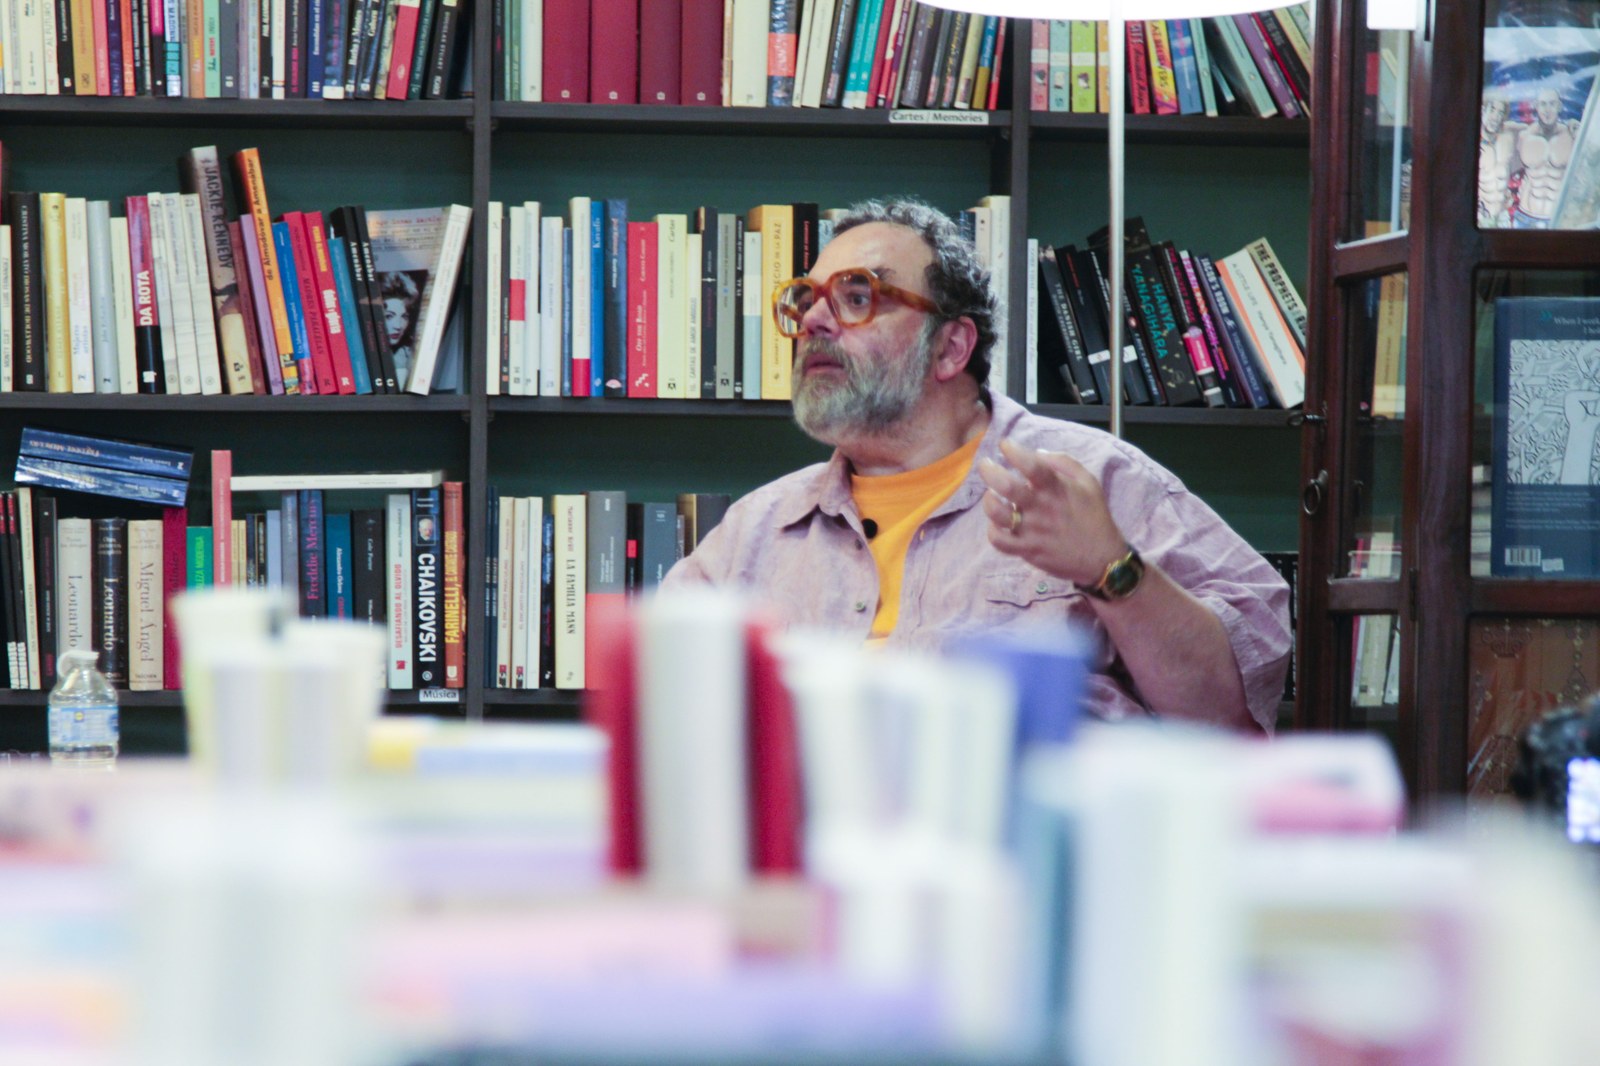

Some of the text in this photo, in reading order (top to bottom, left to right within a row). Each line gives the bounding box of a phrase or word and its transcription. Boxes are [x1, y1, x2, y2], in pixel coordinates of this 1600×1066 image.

[438, 12, 450, 70] DOUGLAS STUART
[1154, 38, 1169, 88] BELIEVERS
[892, 112, 924, 122] Cartes
[933, 111, 982, 123] Memòries
[248, 158, 260, 206] Amenábar
[205, 168, 232, 269] JACKIE KENNEDY
[258, 218, 270, 266] Almodóvar
[266, 270, 273, 281] de
[351, 242, 362, 282] Amenábar
[363, 242, 374, 282] Amenábar
[1254, 242, 1298, 312] THE PROPHETS
[24, 304, 30, 314] DE
[136, 270, 150, 304] ROTA
[1152, 284, 1175, 331] HANYA
[1200, 258, 1230, 315] JACOB'S ROOM
[1235, 269, 1250, 292] LITTLE
[1248, 292, 1258, 306] LIFE
[1258, 311, 1269, 330] Hanya
[140, 307, 152, 326] DA
[304, 278, 324, 355] MADRES PARALELAS
[1054, 283, 1082, 361] THE DANISH GIRL
[1132, 267, 1168, 358] YANAGIHARA
[1232, 331, 1260, 392] VIRGINIA WOOLF
[195, 536, 204, 568] MODERNA
[306, 553, 318, 599] Freddie
[566, 560, 575, 569] LA
[68, 576, 82, 648] Leonardo
[104, 576, 116, 650] Leonardo
[138, 562, 156, 662] Miguel Ángel
[418, 554, 436, 661] CHAIKOVSKI
[444, 583, 460, 644] FARINELLI,
[566, 574, 575, 606] FAMILIA
[567, 612, 575, 634] MANN
[423, 689, 457, 700] Música
